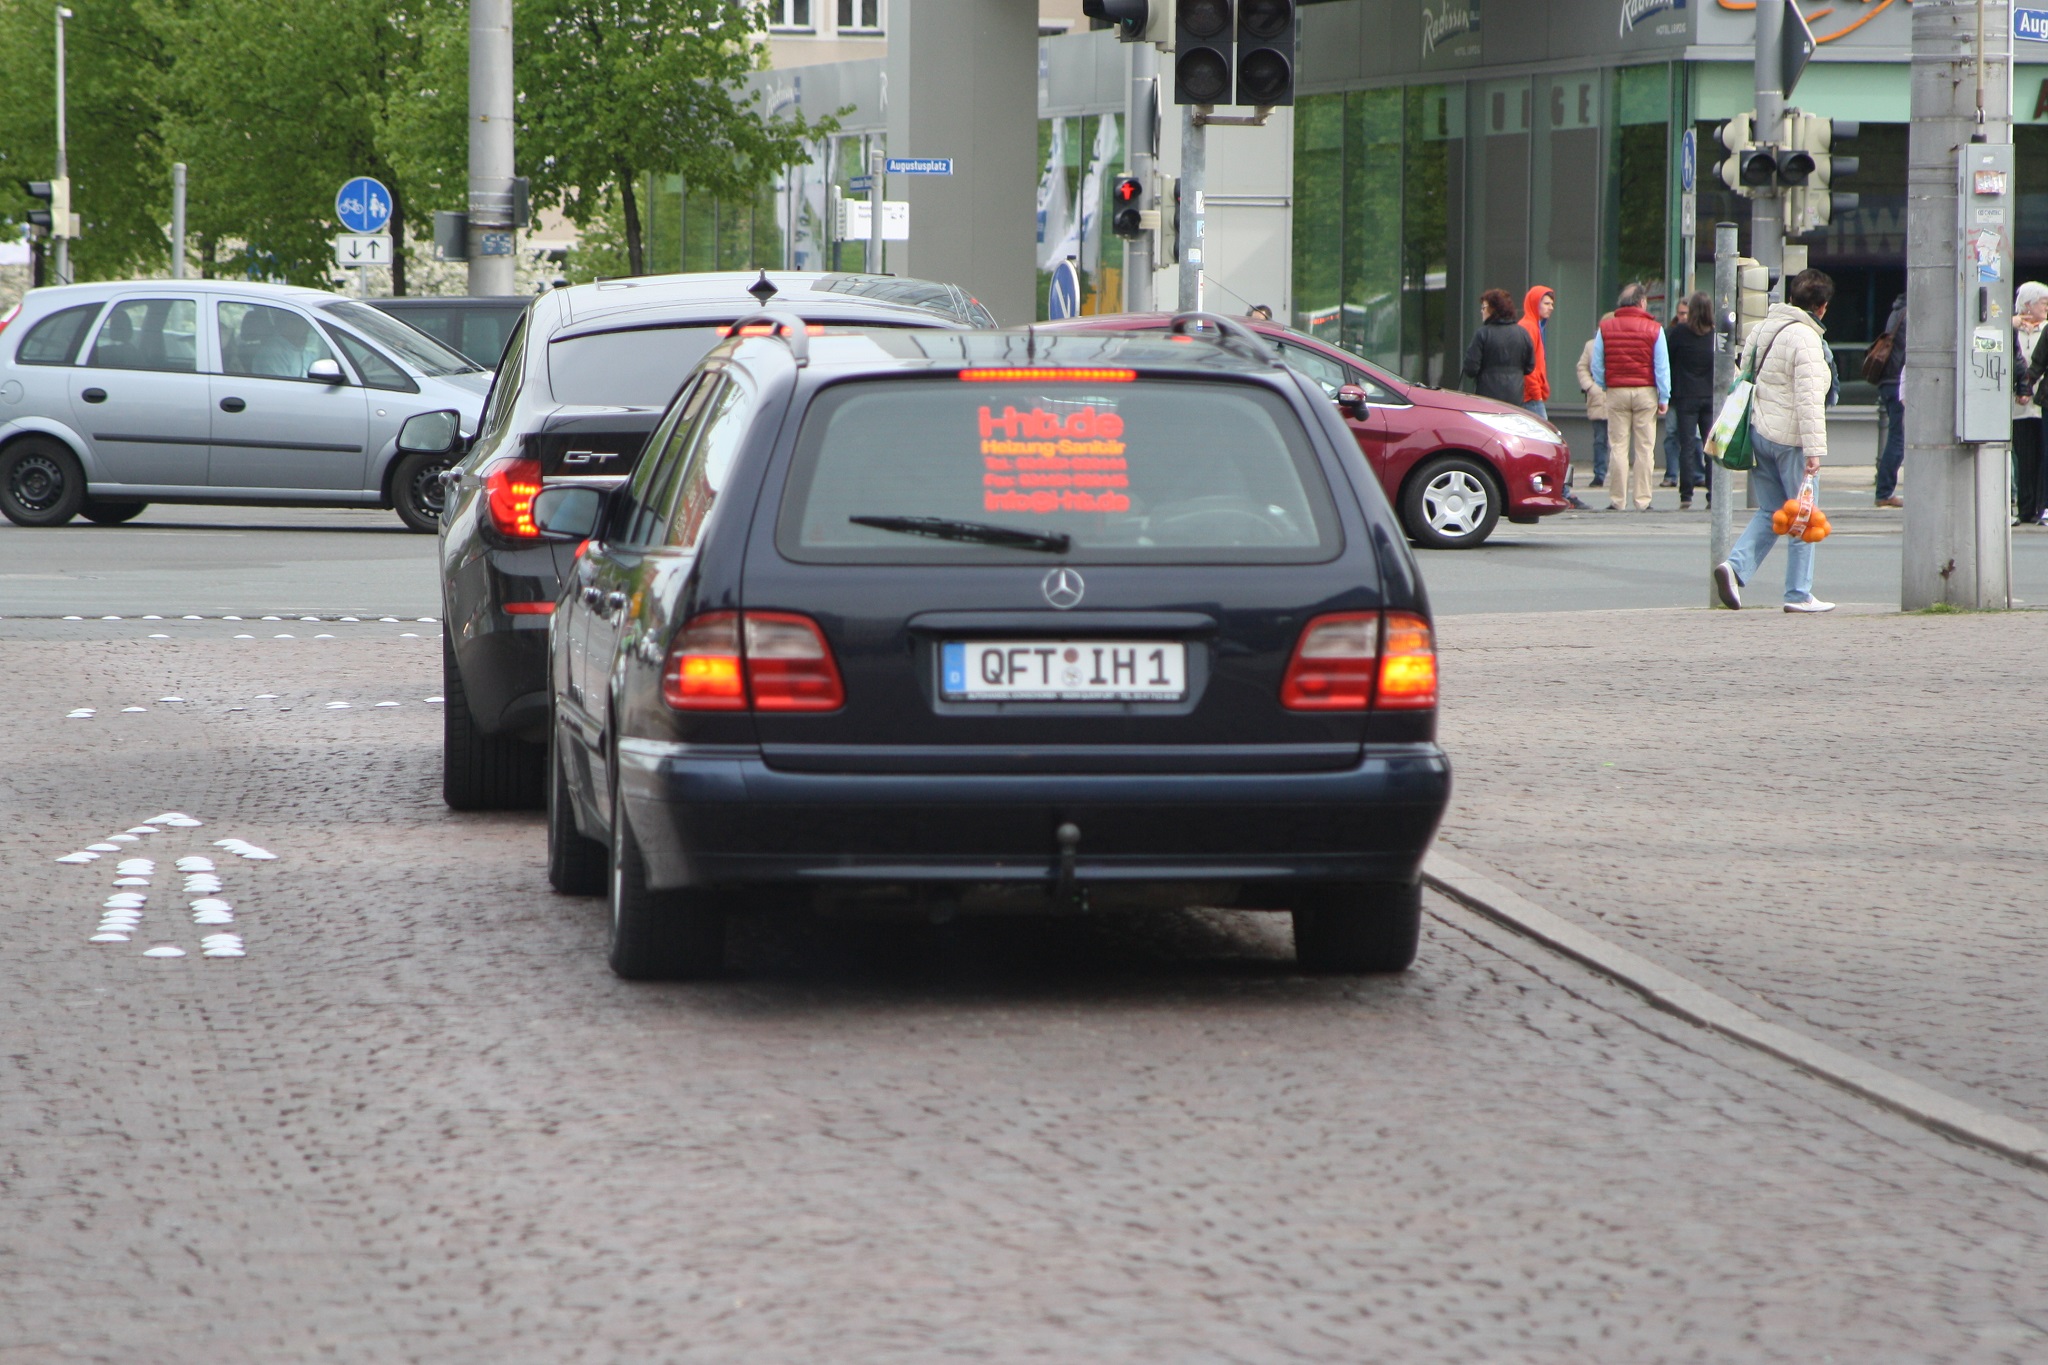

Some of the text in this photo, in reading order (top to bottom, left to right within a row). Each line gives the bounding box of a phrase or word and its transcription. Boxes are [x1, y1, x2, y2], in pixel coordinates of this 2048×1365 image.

[890, 160, 947, 173] Augustusplatz
[563, 450, 619, 463] GT
[981, 648, 1057, 685] QFT
